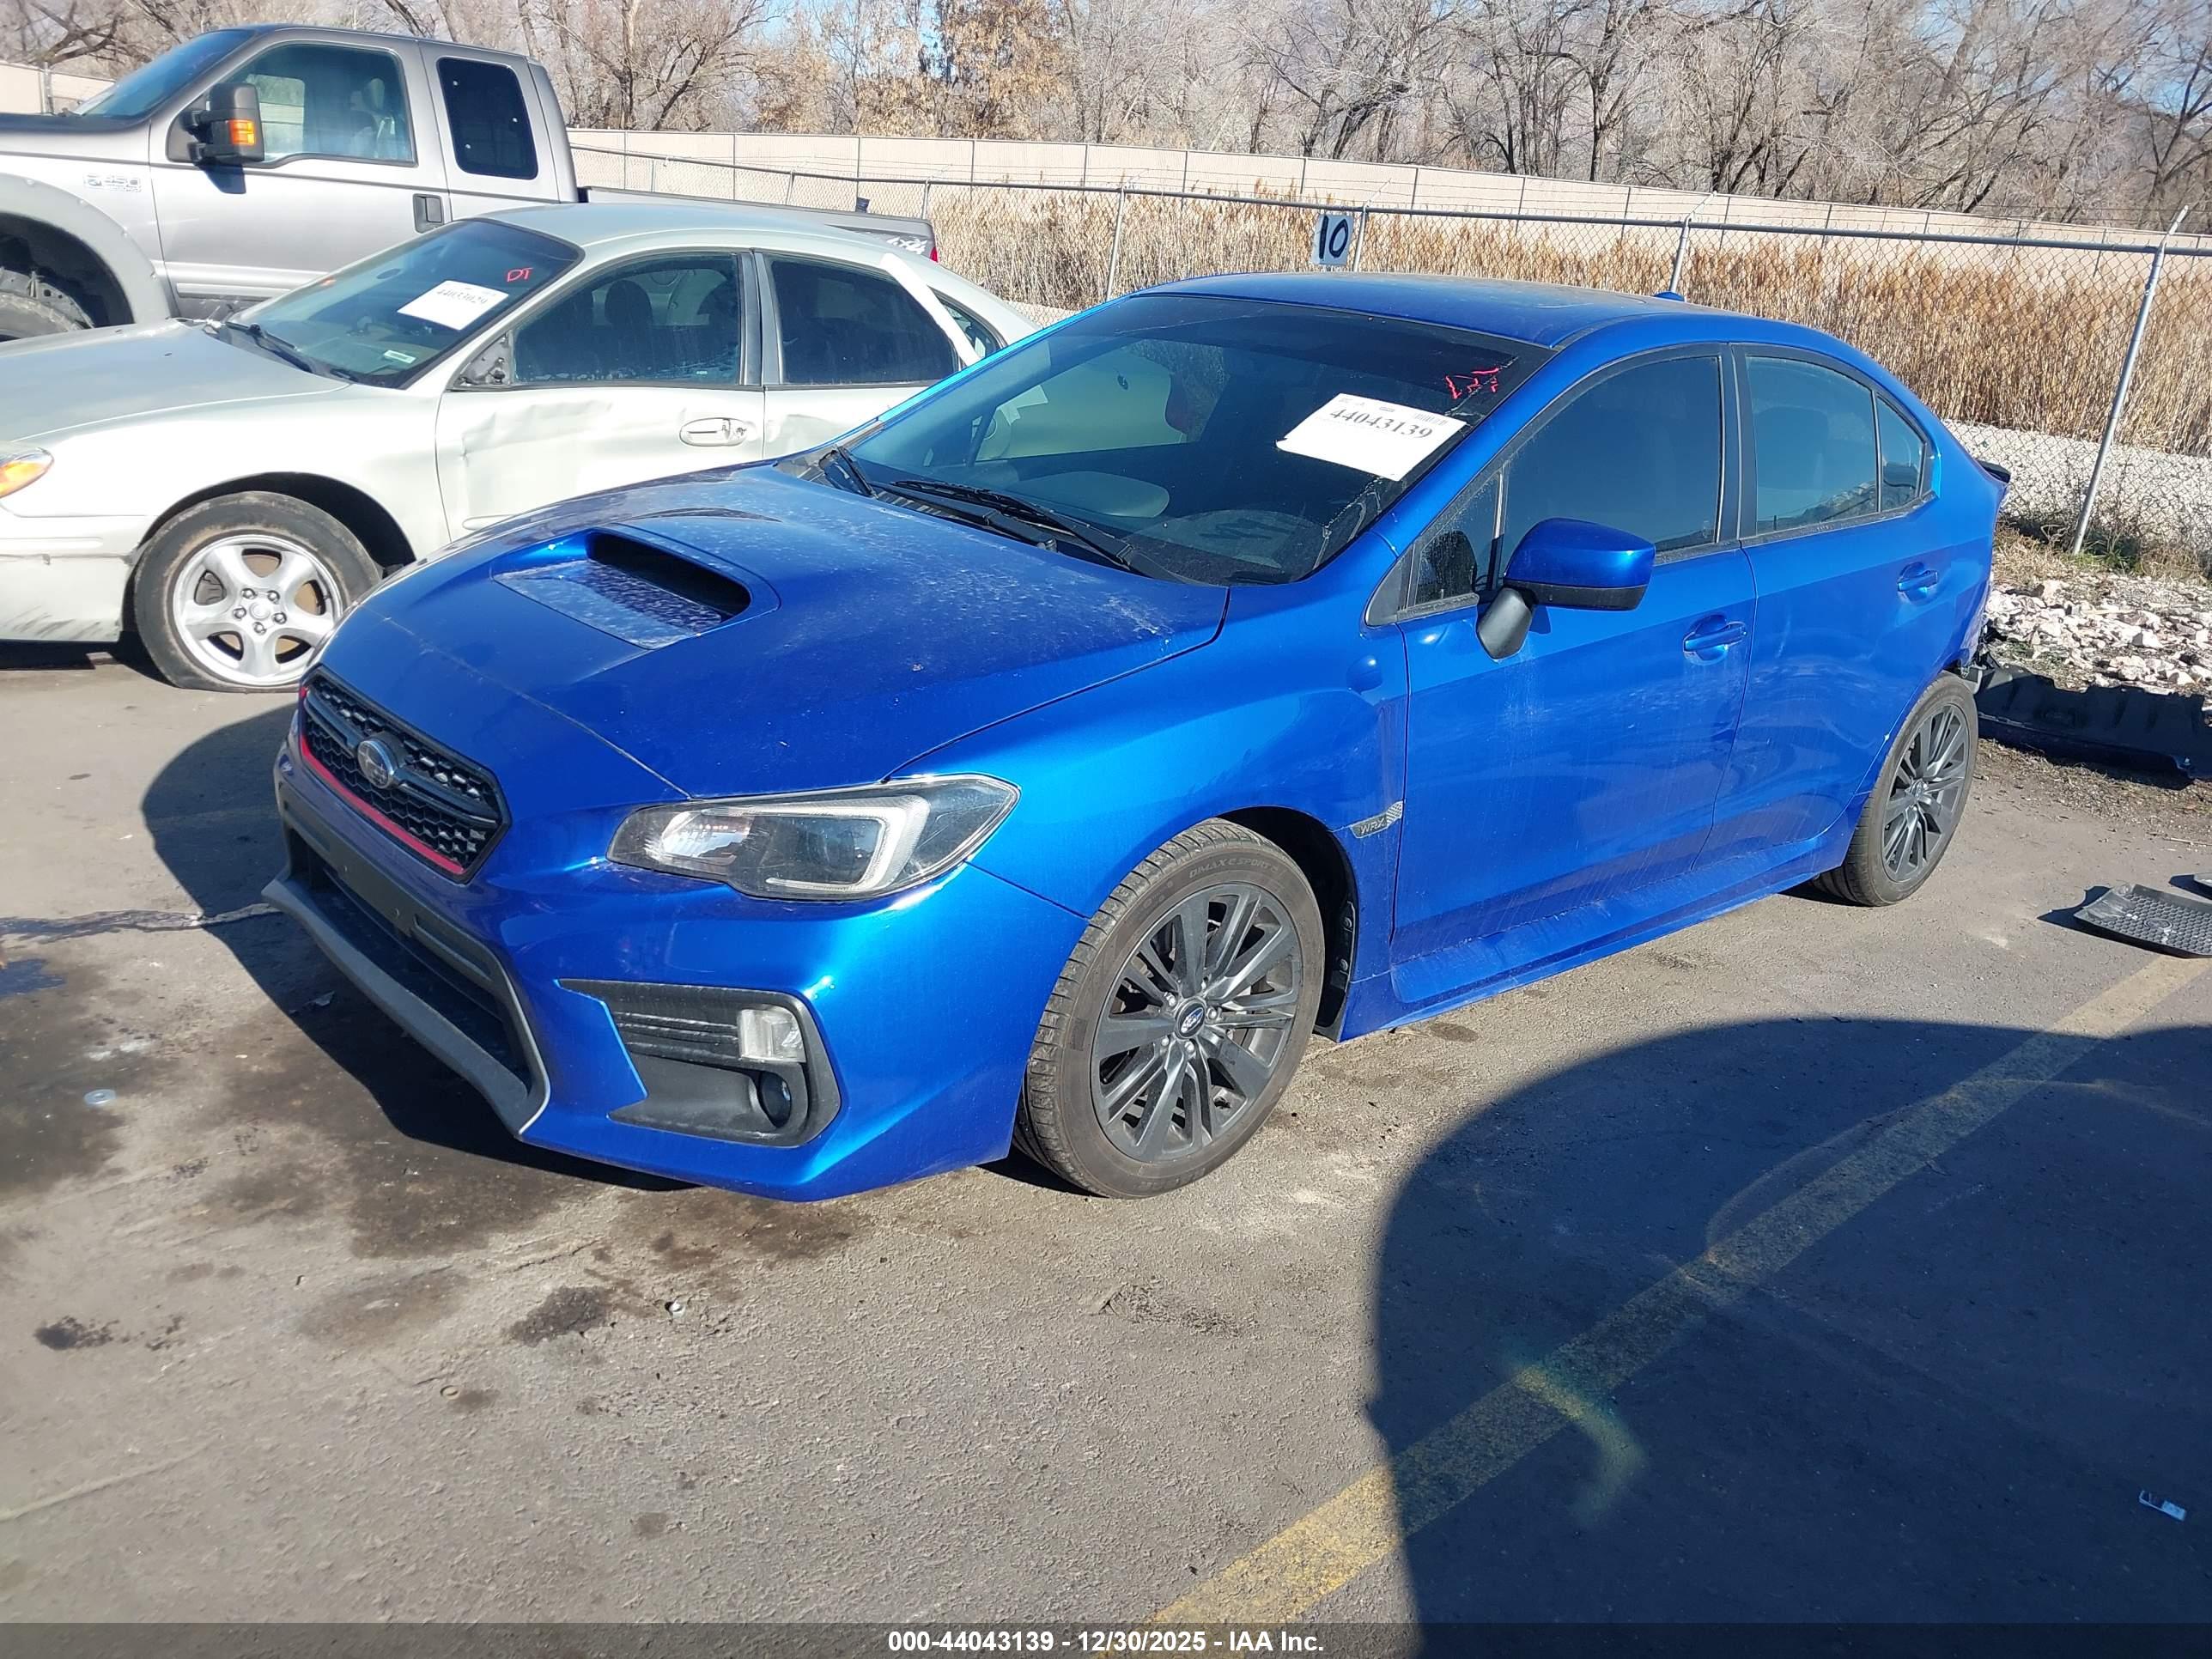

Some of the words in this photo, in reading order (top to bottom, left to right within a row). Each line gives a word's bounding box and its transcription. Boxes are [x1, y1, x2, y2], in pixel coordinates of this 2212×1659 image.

[1318, 216, 1349, 259] 10
[1329, 409, 1433, 439] 44043139
[1360, 817, 1384, 834] WRX
